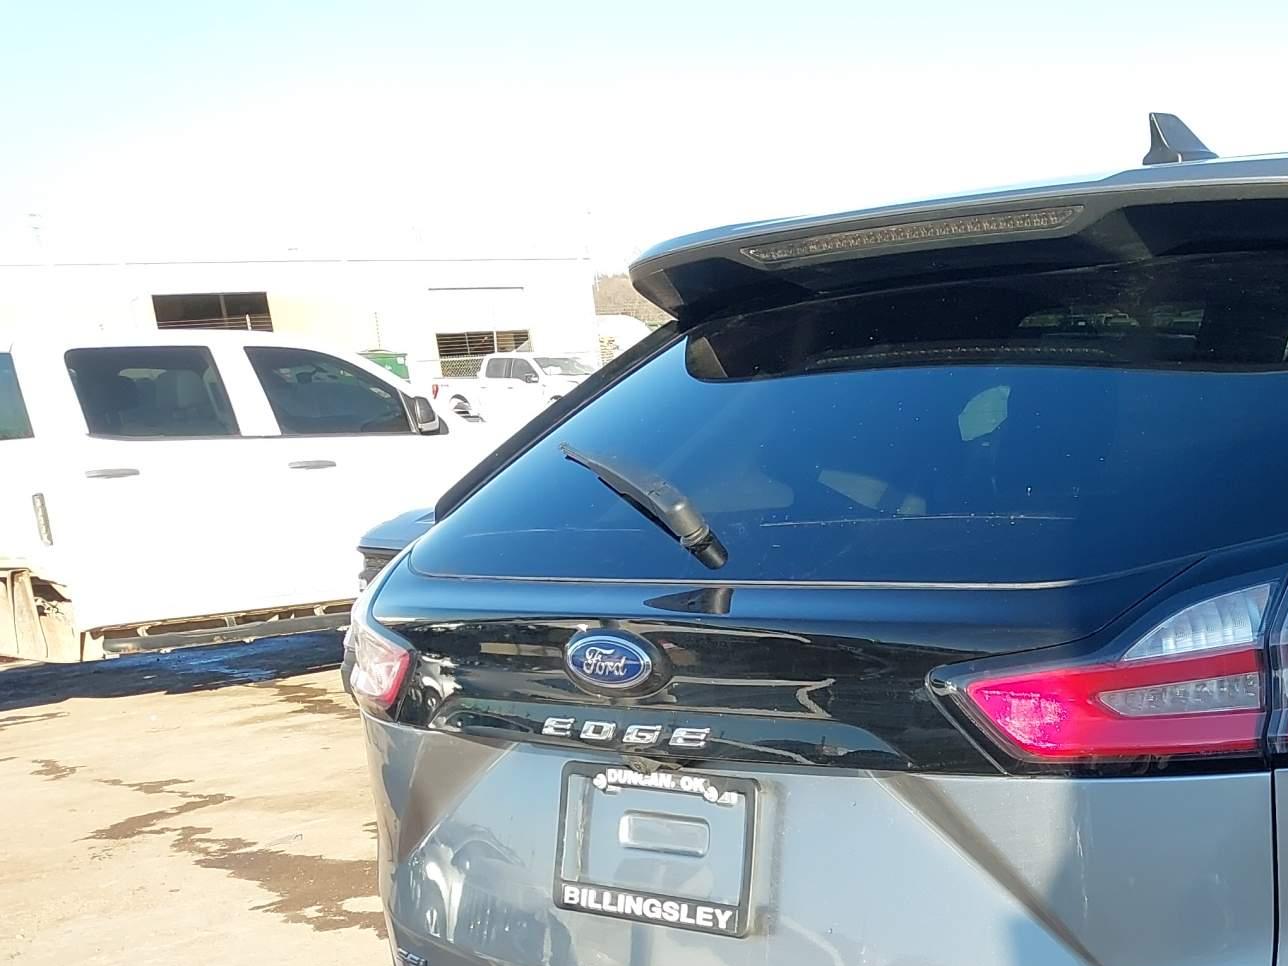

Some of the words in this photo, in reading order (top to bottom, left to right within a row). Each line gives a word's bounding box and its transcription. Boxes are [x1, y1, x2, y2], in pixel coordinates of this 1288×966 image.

[583, 646, 629, 676] Ford
[541, 717, 711, 748] EDGE
[679, 776, 708, 793] OK
[563, 884, 733, 929] BILLINGSLEY
